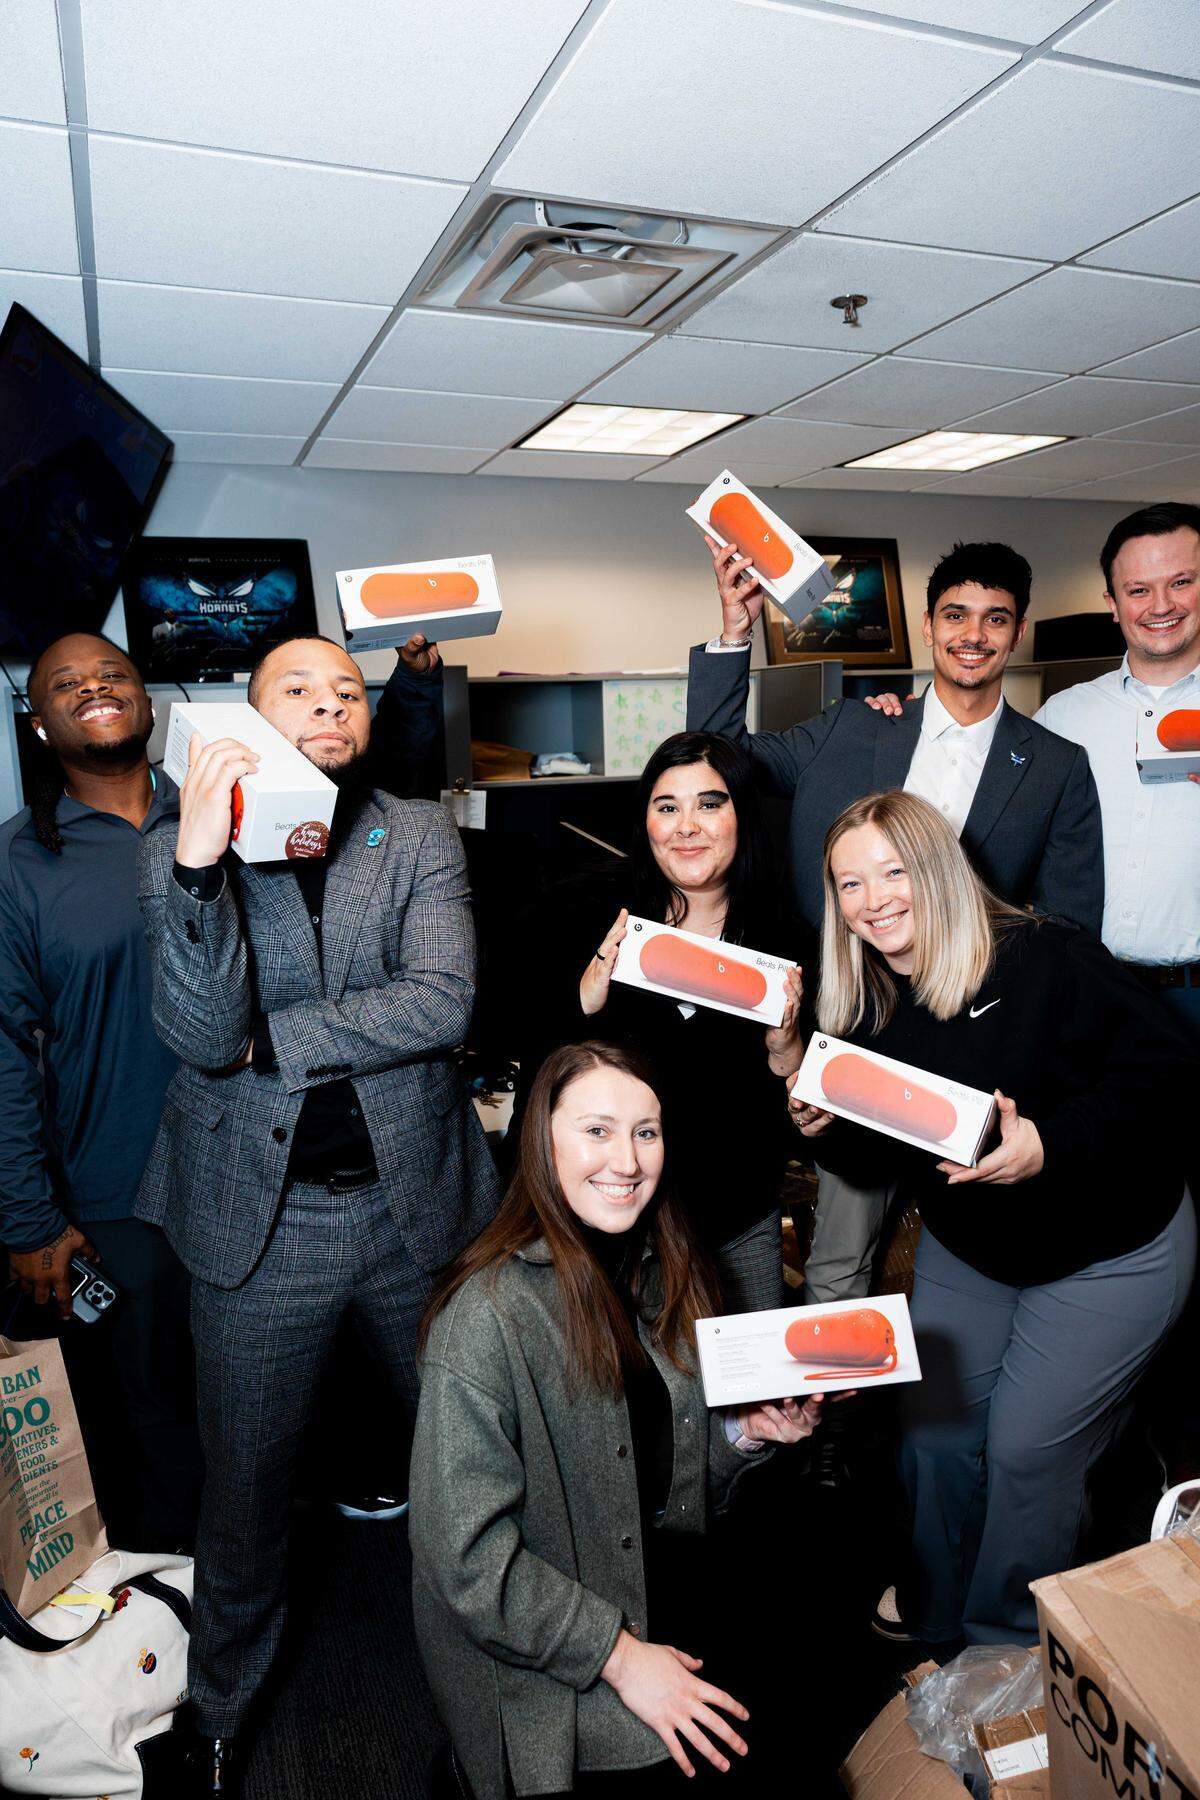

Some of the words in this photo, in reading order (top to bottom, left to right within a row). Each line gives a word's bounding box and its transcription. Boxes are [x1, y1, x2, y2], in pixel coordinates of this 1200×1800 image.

[199, 602, 248, 614] HORNETS
[756, 957, 777, 970] Beats
[1, 1365, 42, 1395] BAN
[20, 1453, 46, 1472] FOOD
[19, 1500, 68, 1546] PEACE
[26, 1531, 74, 1581] MIND
